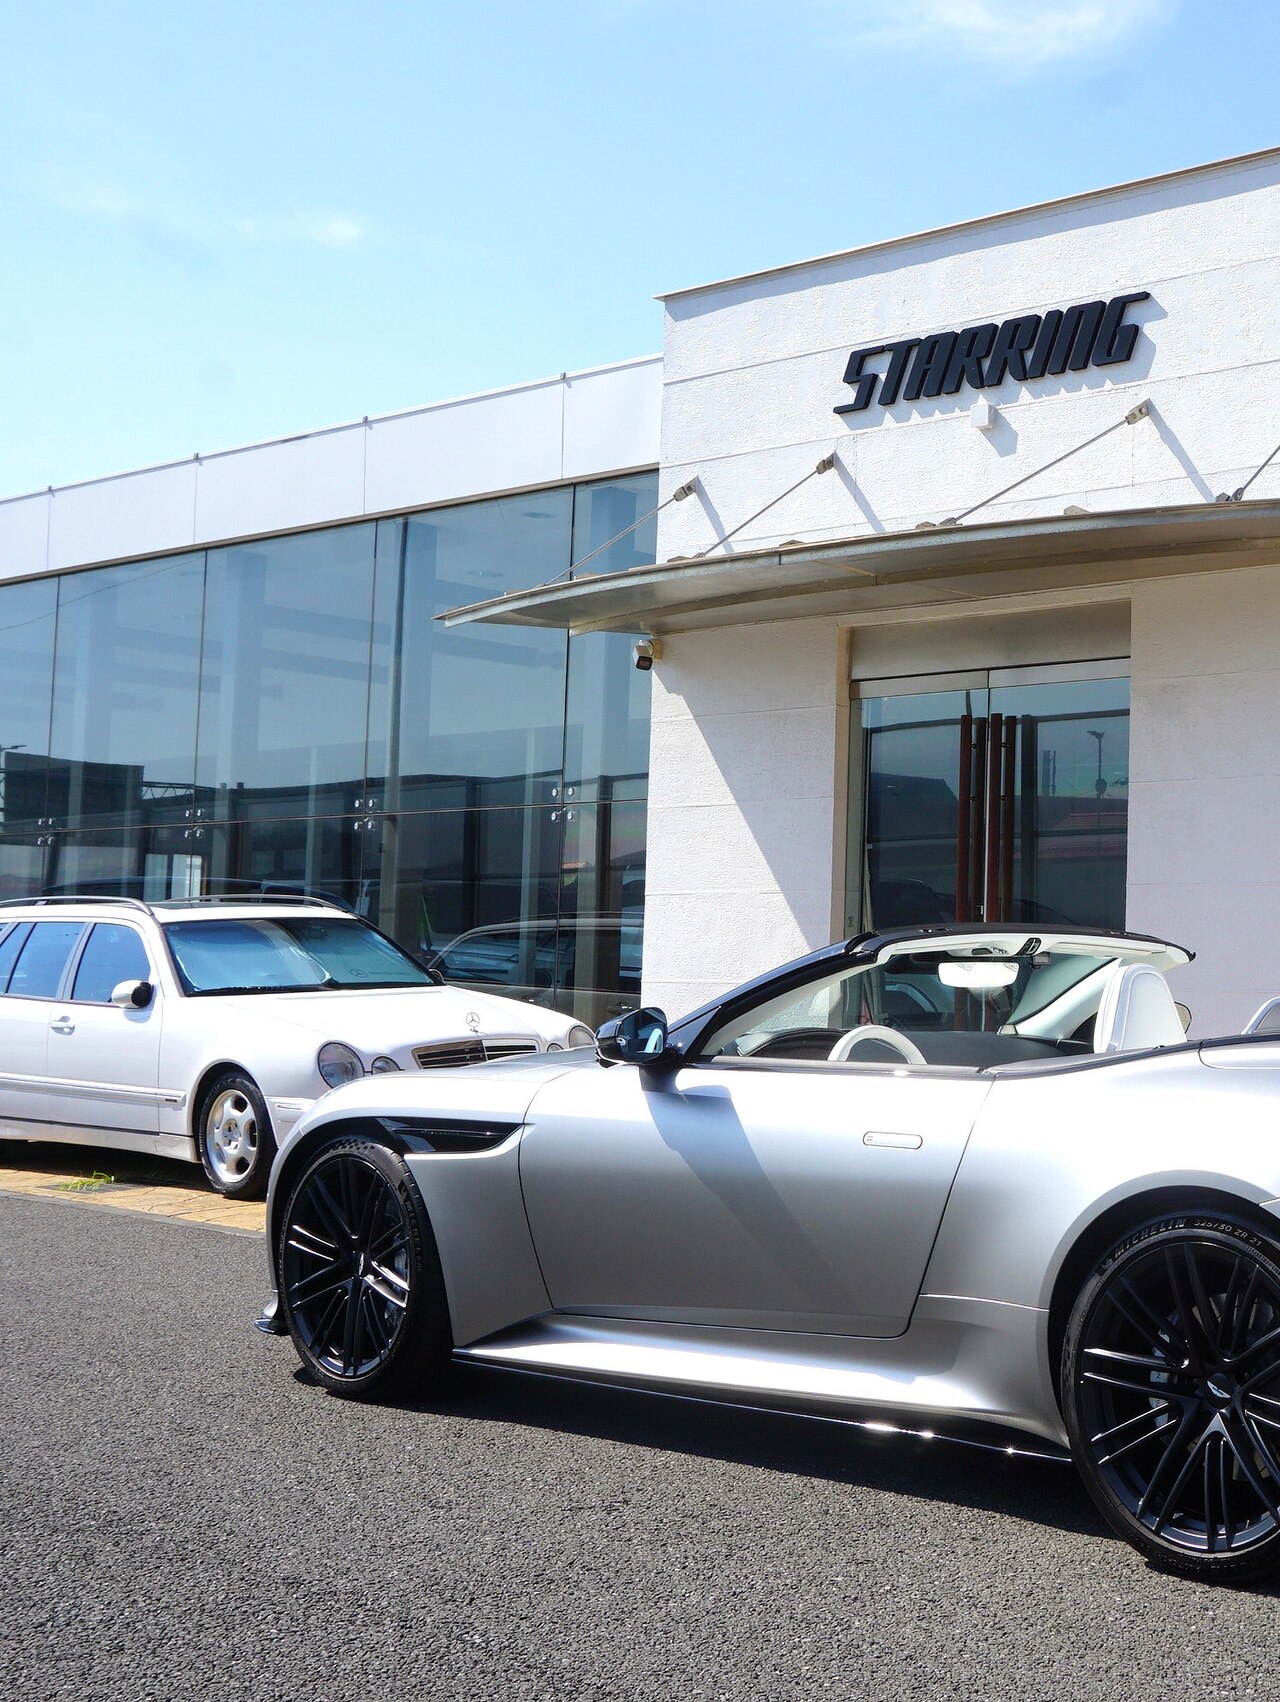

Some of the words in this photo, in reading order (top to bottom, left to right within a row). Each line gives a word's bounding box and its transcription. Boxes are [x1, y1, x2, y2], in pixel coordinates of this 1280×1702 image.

[833, 291, 1150, 414] STARRING
[1114, 1218, 1186, 1258] MICHELIN
[1234, 1228, 1249, 1239] ZR
[1249, 1237, 1263, 1247] 21
